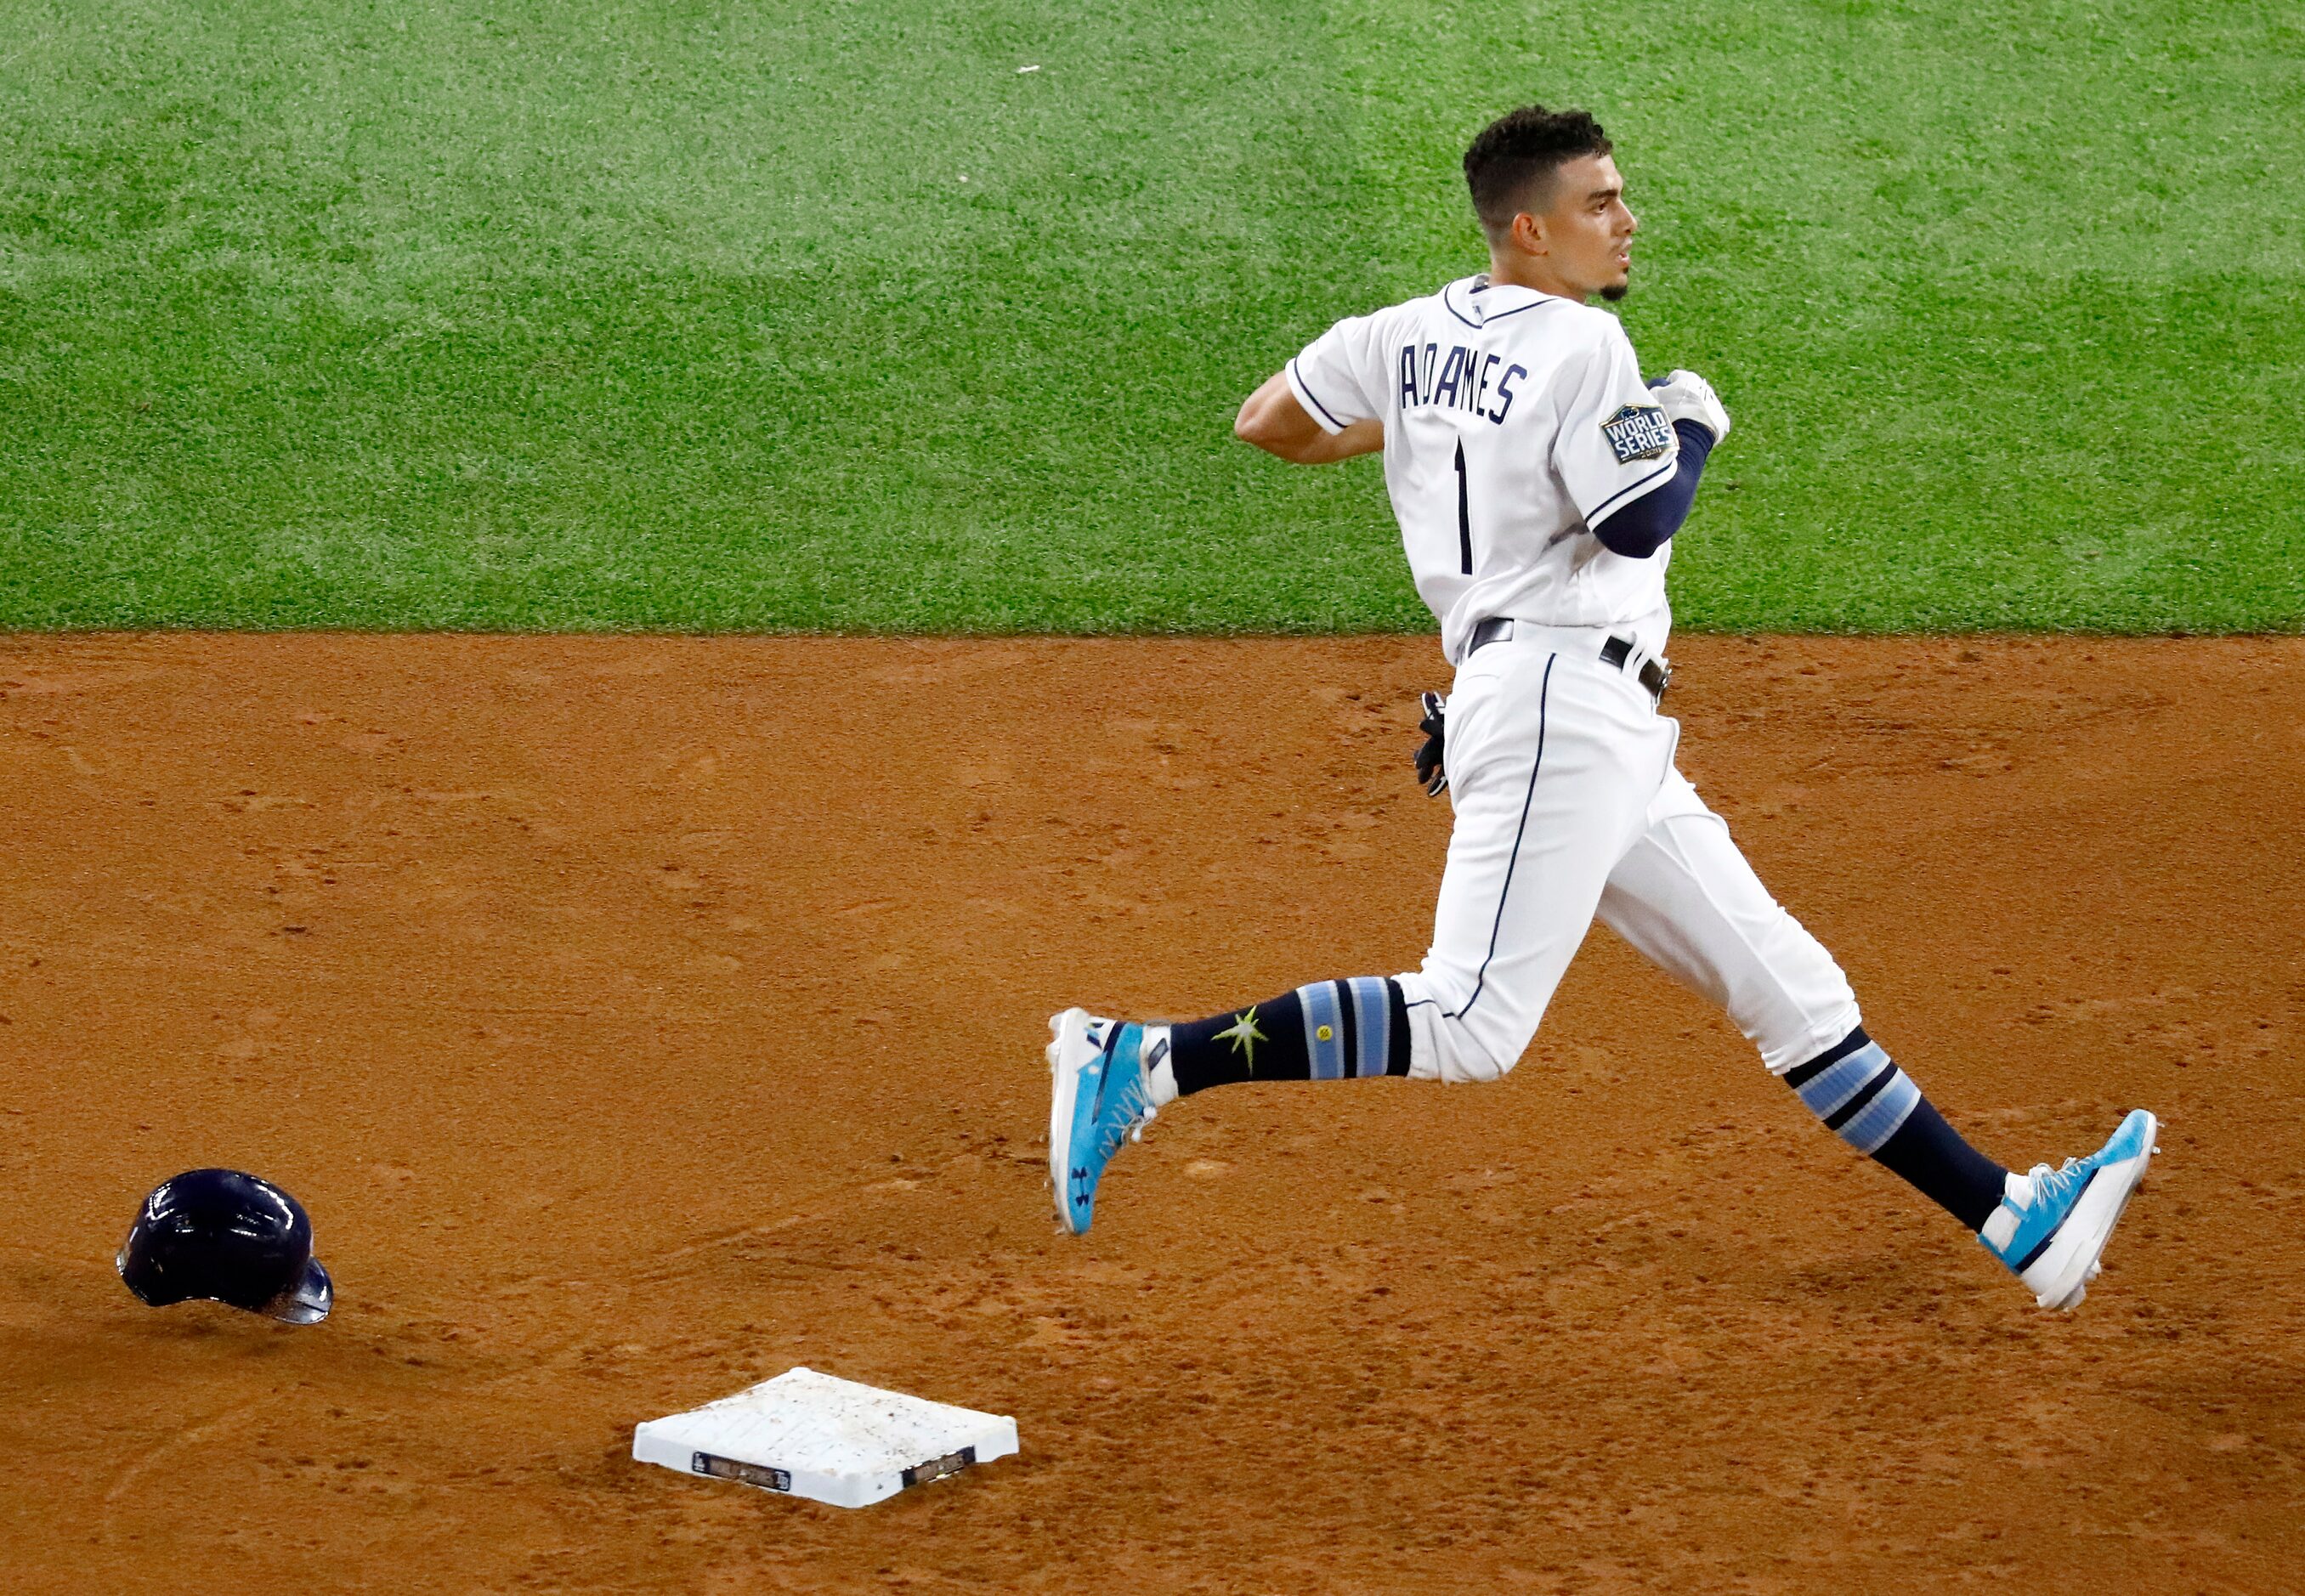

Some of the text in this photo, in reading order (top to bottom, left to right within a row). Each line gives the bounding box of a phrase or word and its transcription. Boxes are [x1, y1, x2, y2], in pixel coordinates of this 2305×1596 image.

[1402, 342, 1527, 425] ADAMES
[1606, 411, 1667, 442] WORLD
[1615, 427, 1674, 459] SERIES
[1454, 435, 1473, 575] 1
